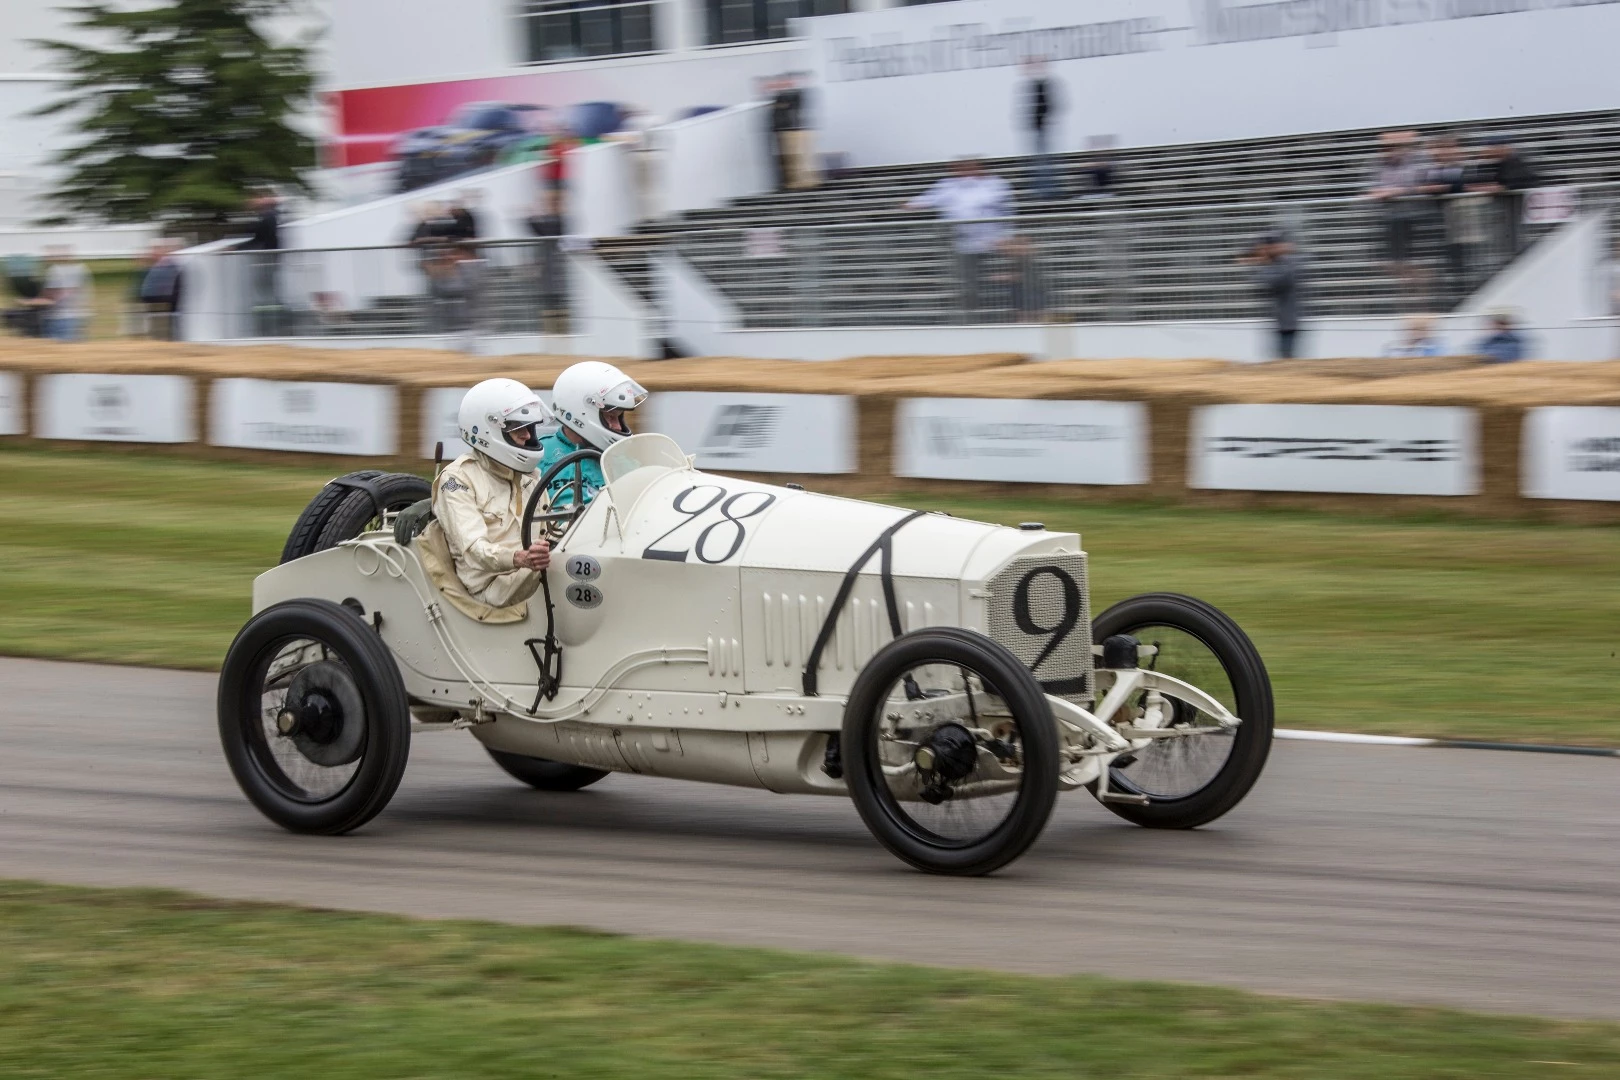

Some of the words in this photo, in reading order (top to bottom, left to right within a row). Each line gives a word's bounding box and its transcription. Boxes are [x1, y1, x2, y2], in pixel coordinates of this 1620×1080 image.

[642, 485, 776, 564] 28
[575, 561, 591, 576] 28
[575, 588, 592, 602] 28
